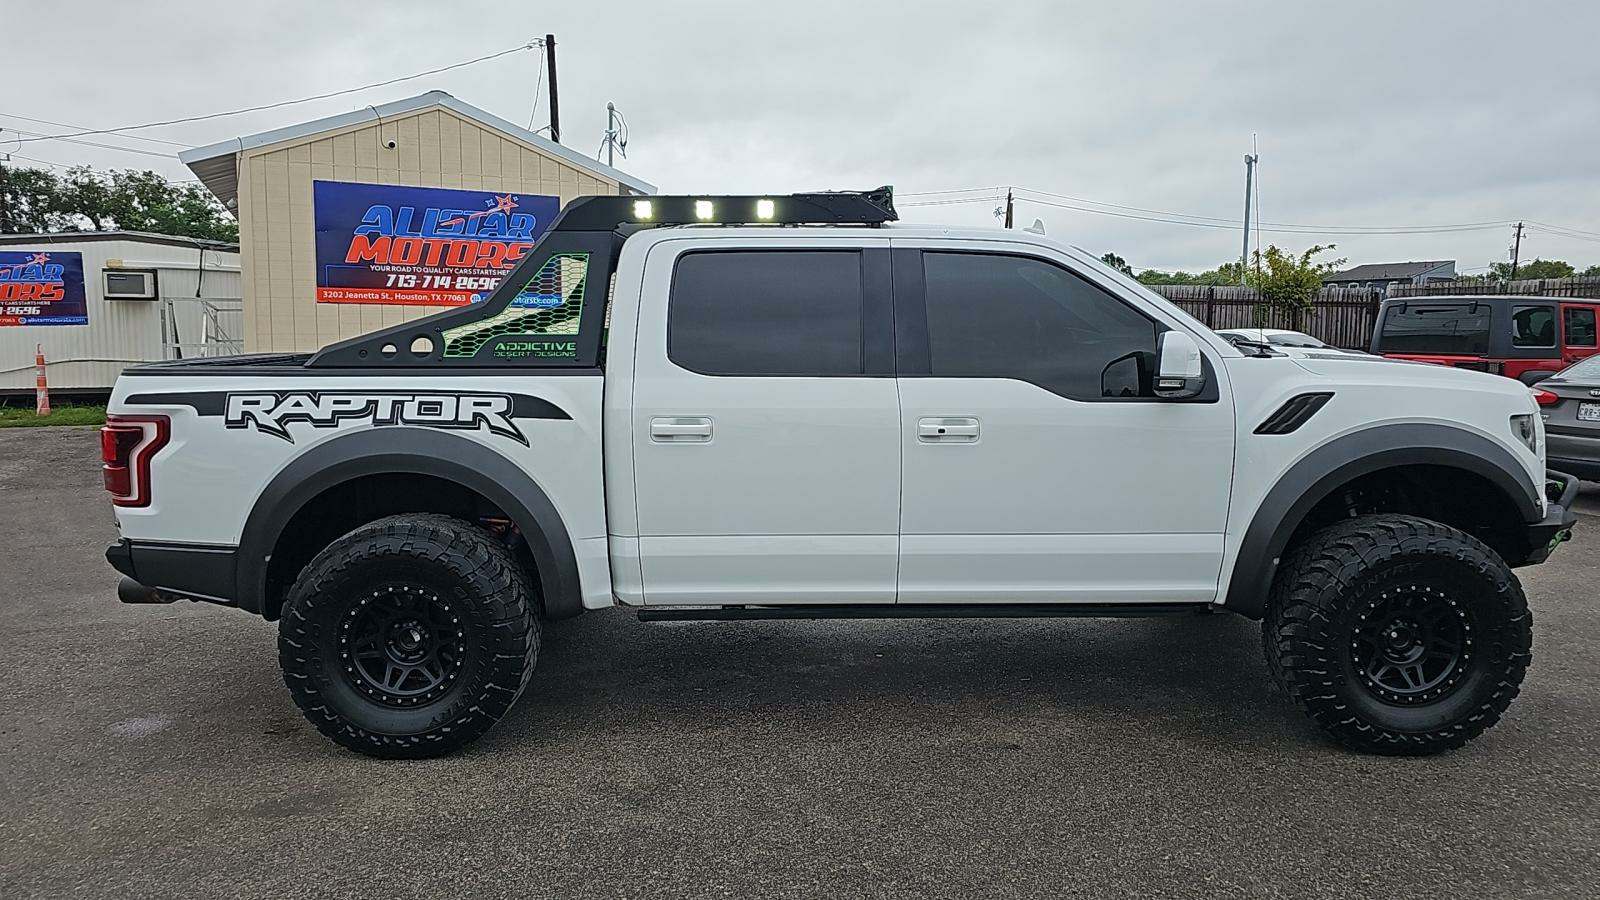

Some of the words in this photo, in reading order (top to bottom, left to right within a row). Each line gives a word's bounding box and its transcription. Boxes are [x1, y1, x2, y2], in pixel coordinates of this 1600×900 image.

[353, 204, 536, 242] ALLSTAR
[370, 264, 391, 272] YOUR
[392, 265, 412, 273] ROAD
[423, 267, 453, 275] QUALITY
[473, 268, 496, 276] STARTS
[386, 273, 501, 290] 713-714-2696
[323, 290, 343, 299] 3202
[344, 291, 380, 300] Jeanetta
[395, 293, 430, 302] Houston,
[431, 293, 441, 301] TX
[442, 294, 466, 302] 77063
[494, 342, 577, 351] ADDICTIVE
[225, 391, 530, 447] RAPTOR
